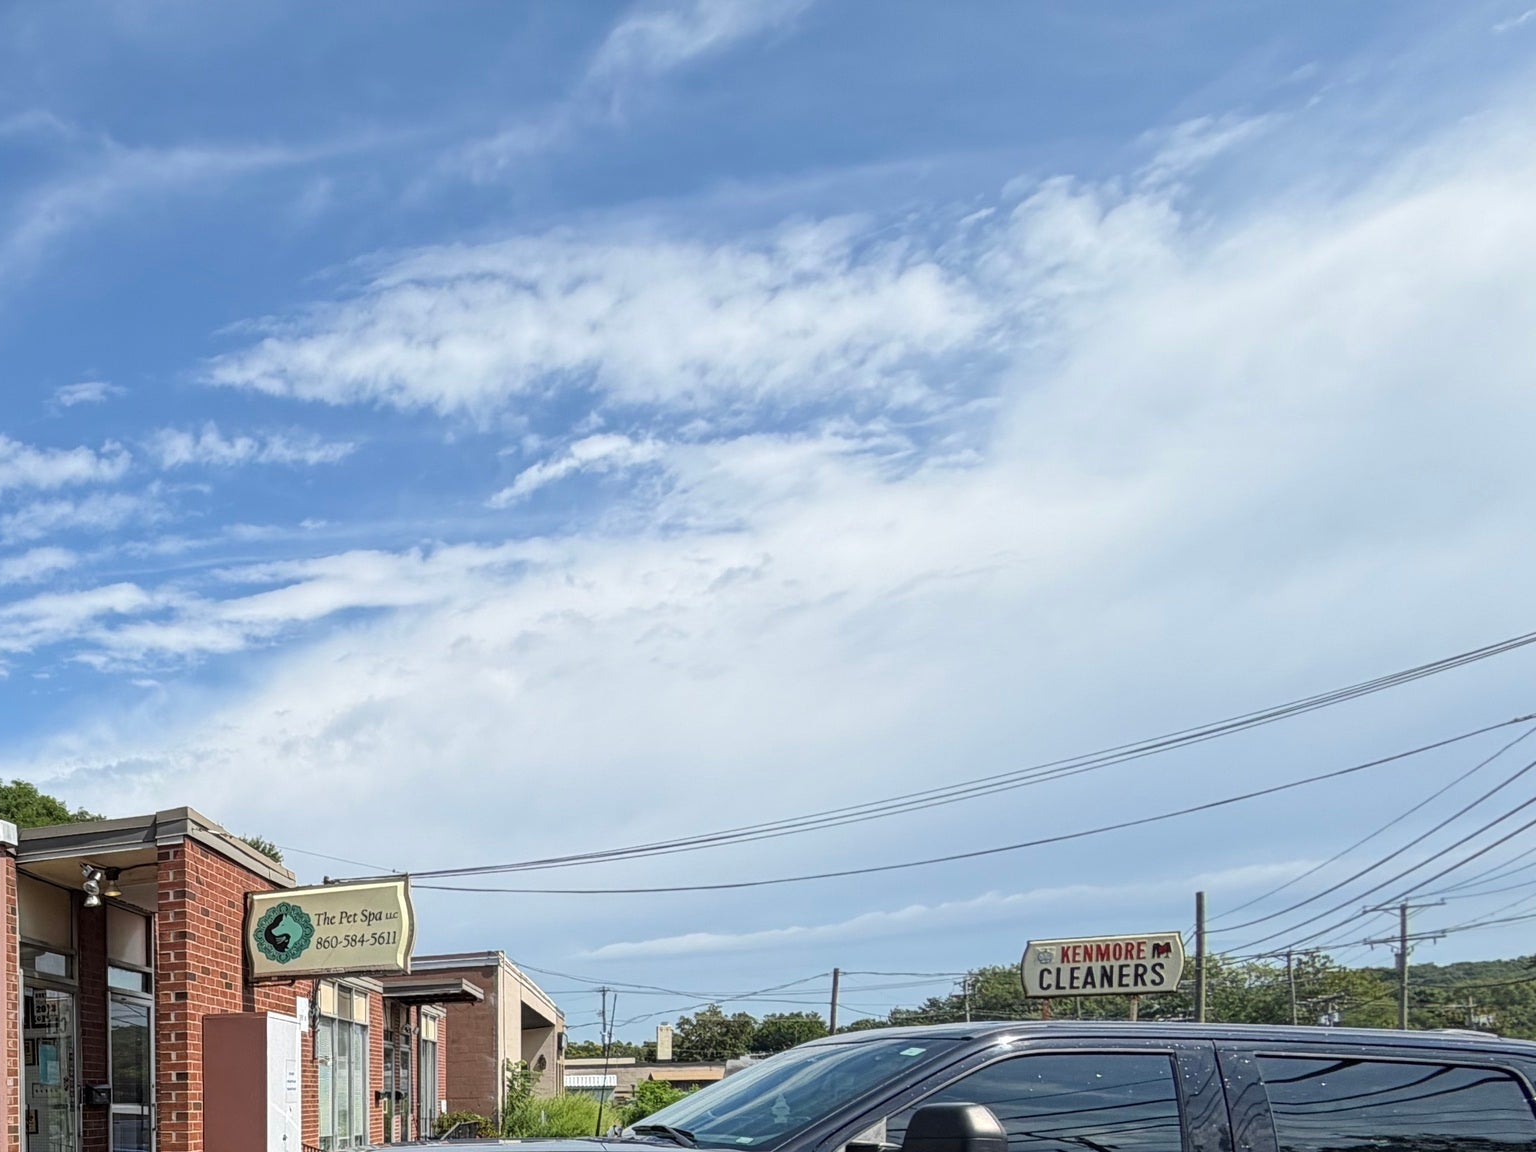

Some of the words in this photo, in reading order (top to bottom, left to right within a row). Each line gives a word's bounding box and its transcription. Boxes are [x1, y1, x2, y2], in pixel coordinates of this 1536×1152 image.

[314, 911, 335, 927] The
[338, 910, 358, 925] Pet
[360, 908, 383, 927] Spa
[385, 911, 399, 920] LLC
[316, 930, 397, 950] 860-584-5611
[1060, 941, 1147, 964] KENMORE
[1038, 962, 1165, 991] CLEANERS
